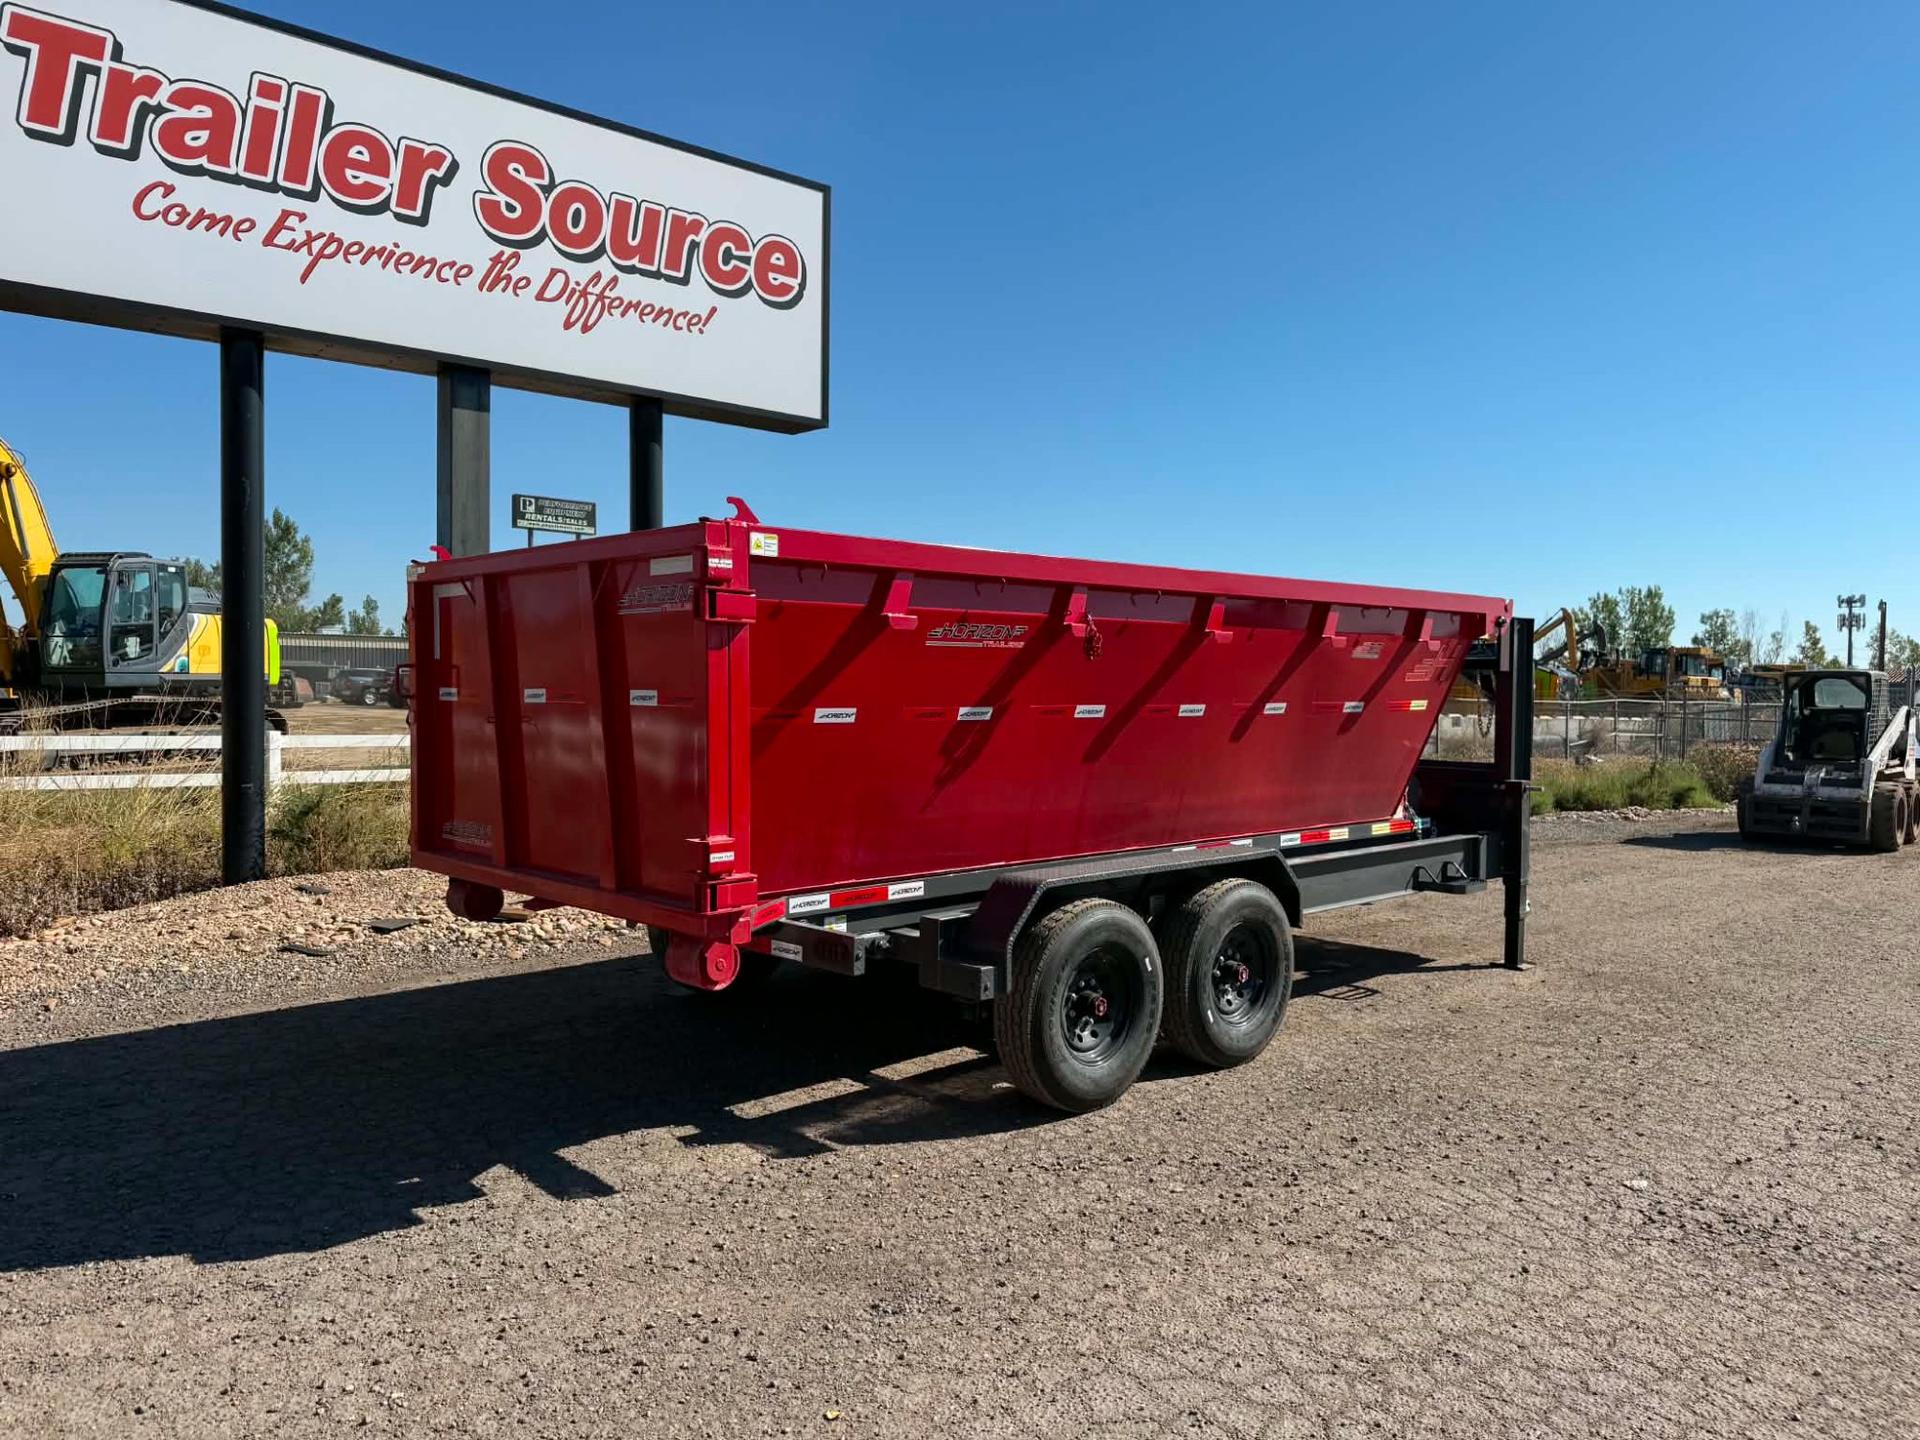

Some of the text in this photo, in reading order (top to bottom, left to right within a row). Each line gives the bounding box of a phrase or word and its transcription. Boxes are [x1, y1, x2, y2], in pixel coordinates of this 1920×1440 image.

[1, 2, 806, 309] Trailer Source
[132, 180, 718, 336] Come Experience the Difference!
[927, 622, 1029, 640] HORIZON
[818, 712, 855, 720] HORIZON
[890, 885, 923, 896] HORIZON
[791, 898, 828, 909] HORIZON
